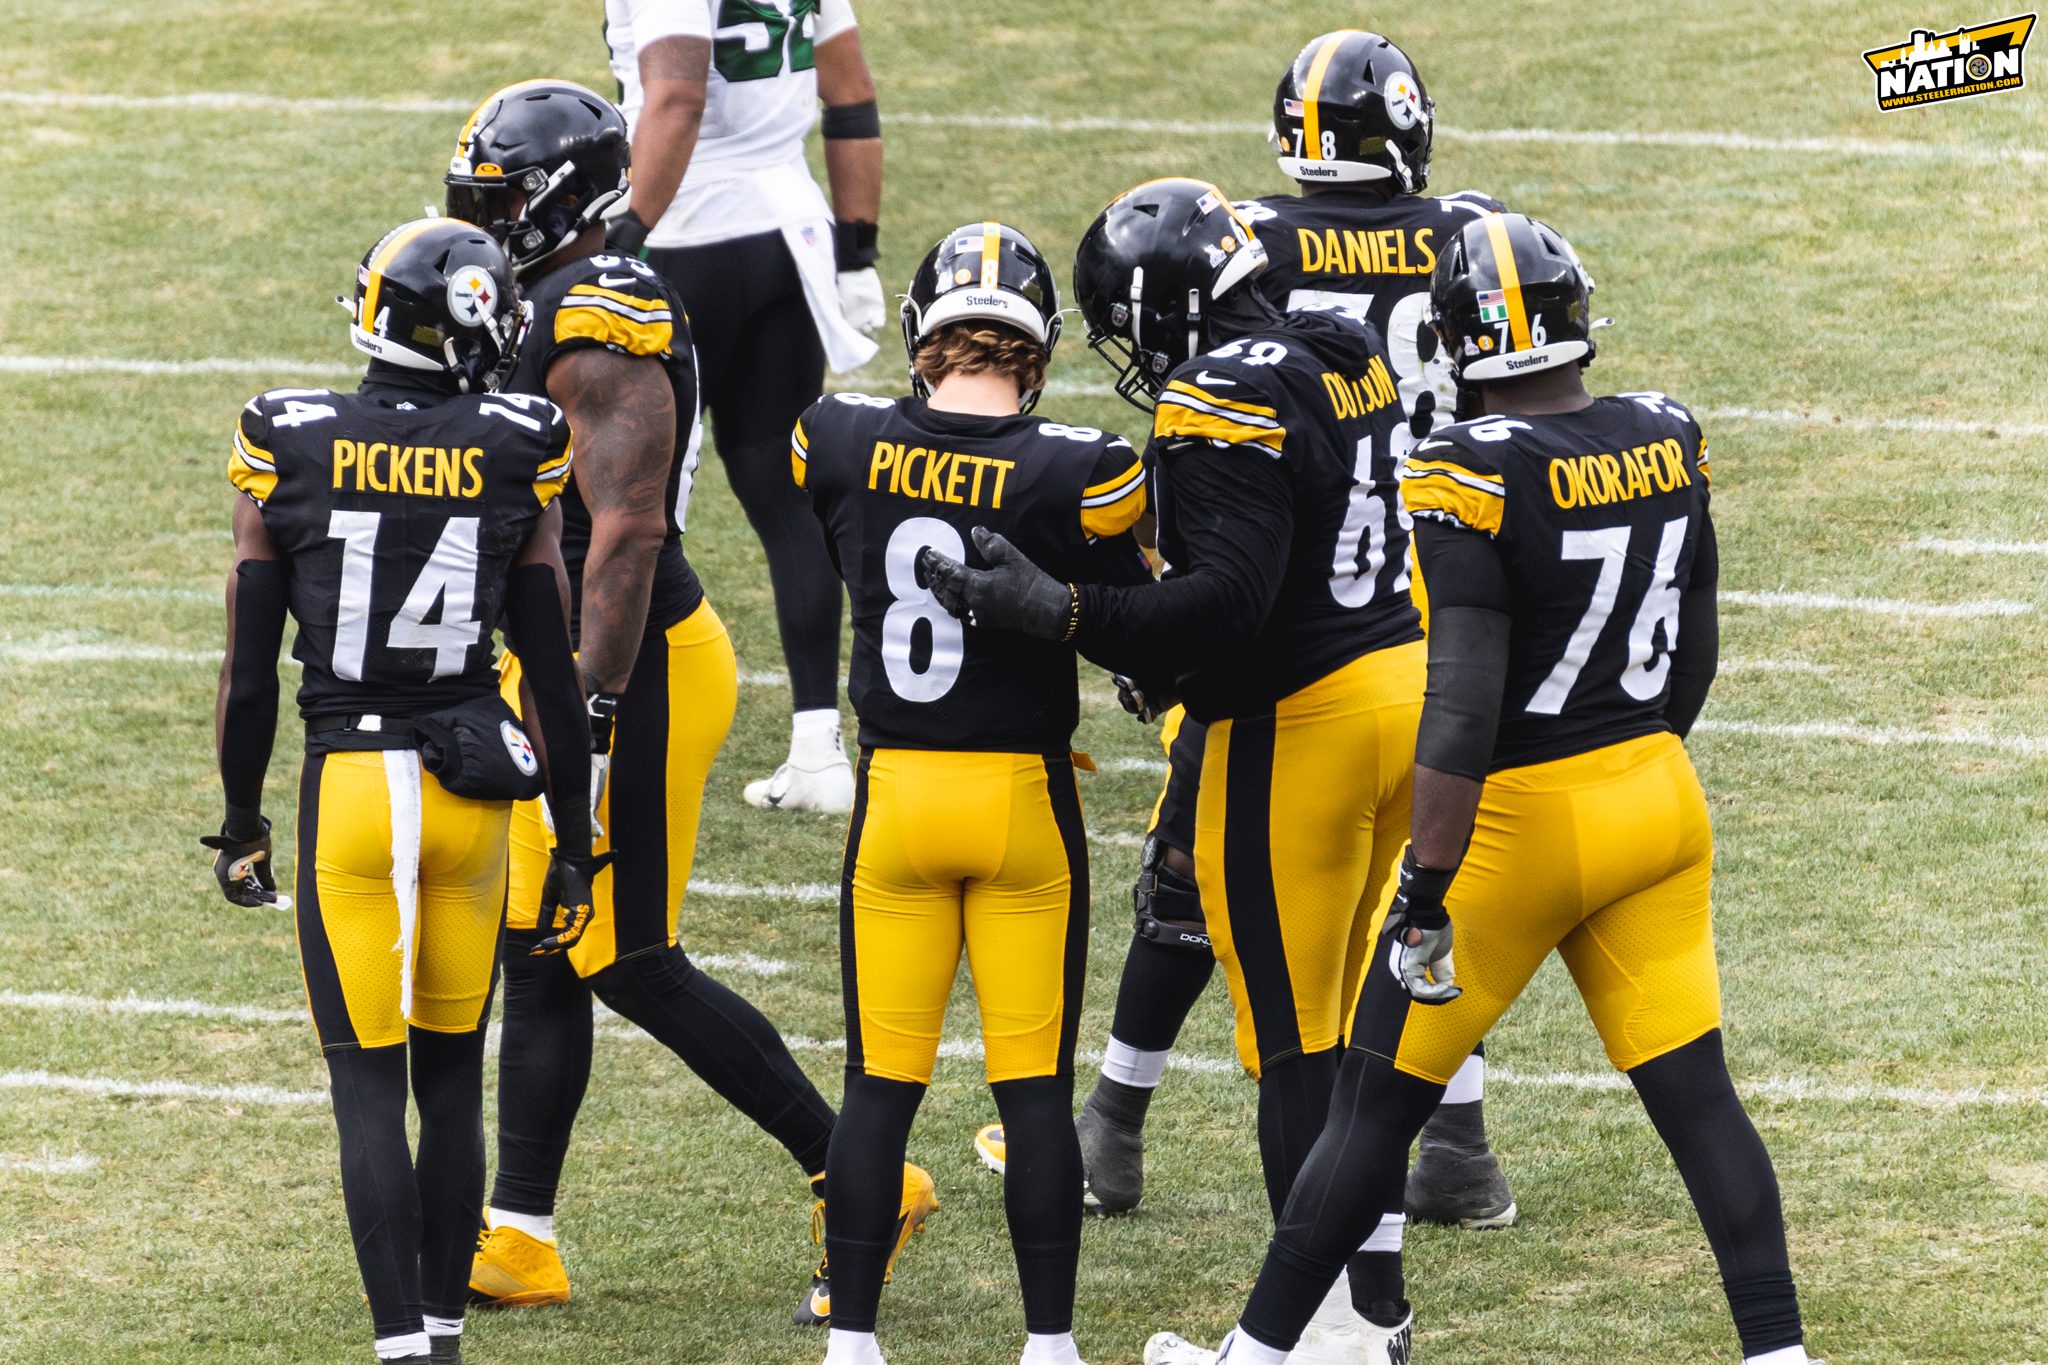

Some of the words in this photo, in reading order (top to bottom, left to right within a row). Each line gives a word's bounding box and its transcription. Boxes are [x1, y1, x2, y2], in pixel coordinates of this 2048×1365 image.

[1300, 166, 1338, 177] Steelers
[983, 259, 999, 289] 8
[1297, 228, 1437, 275] DANIELS
[966, 295, 1008, 309] Steelers
[1506, 354, 1549, 371] Steelers
[264, 388, 338, 428] 14
[333, 439, 484, 499] PICKENS
[868, 440, 1016, 510] PICKETT
[1549, 438, 1691, 509] OKORAFOR
[327, 510, 481, 684] 14
[881, 516, 966, 703] 8
[1525, 515, 1689, 715] 76
